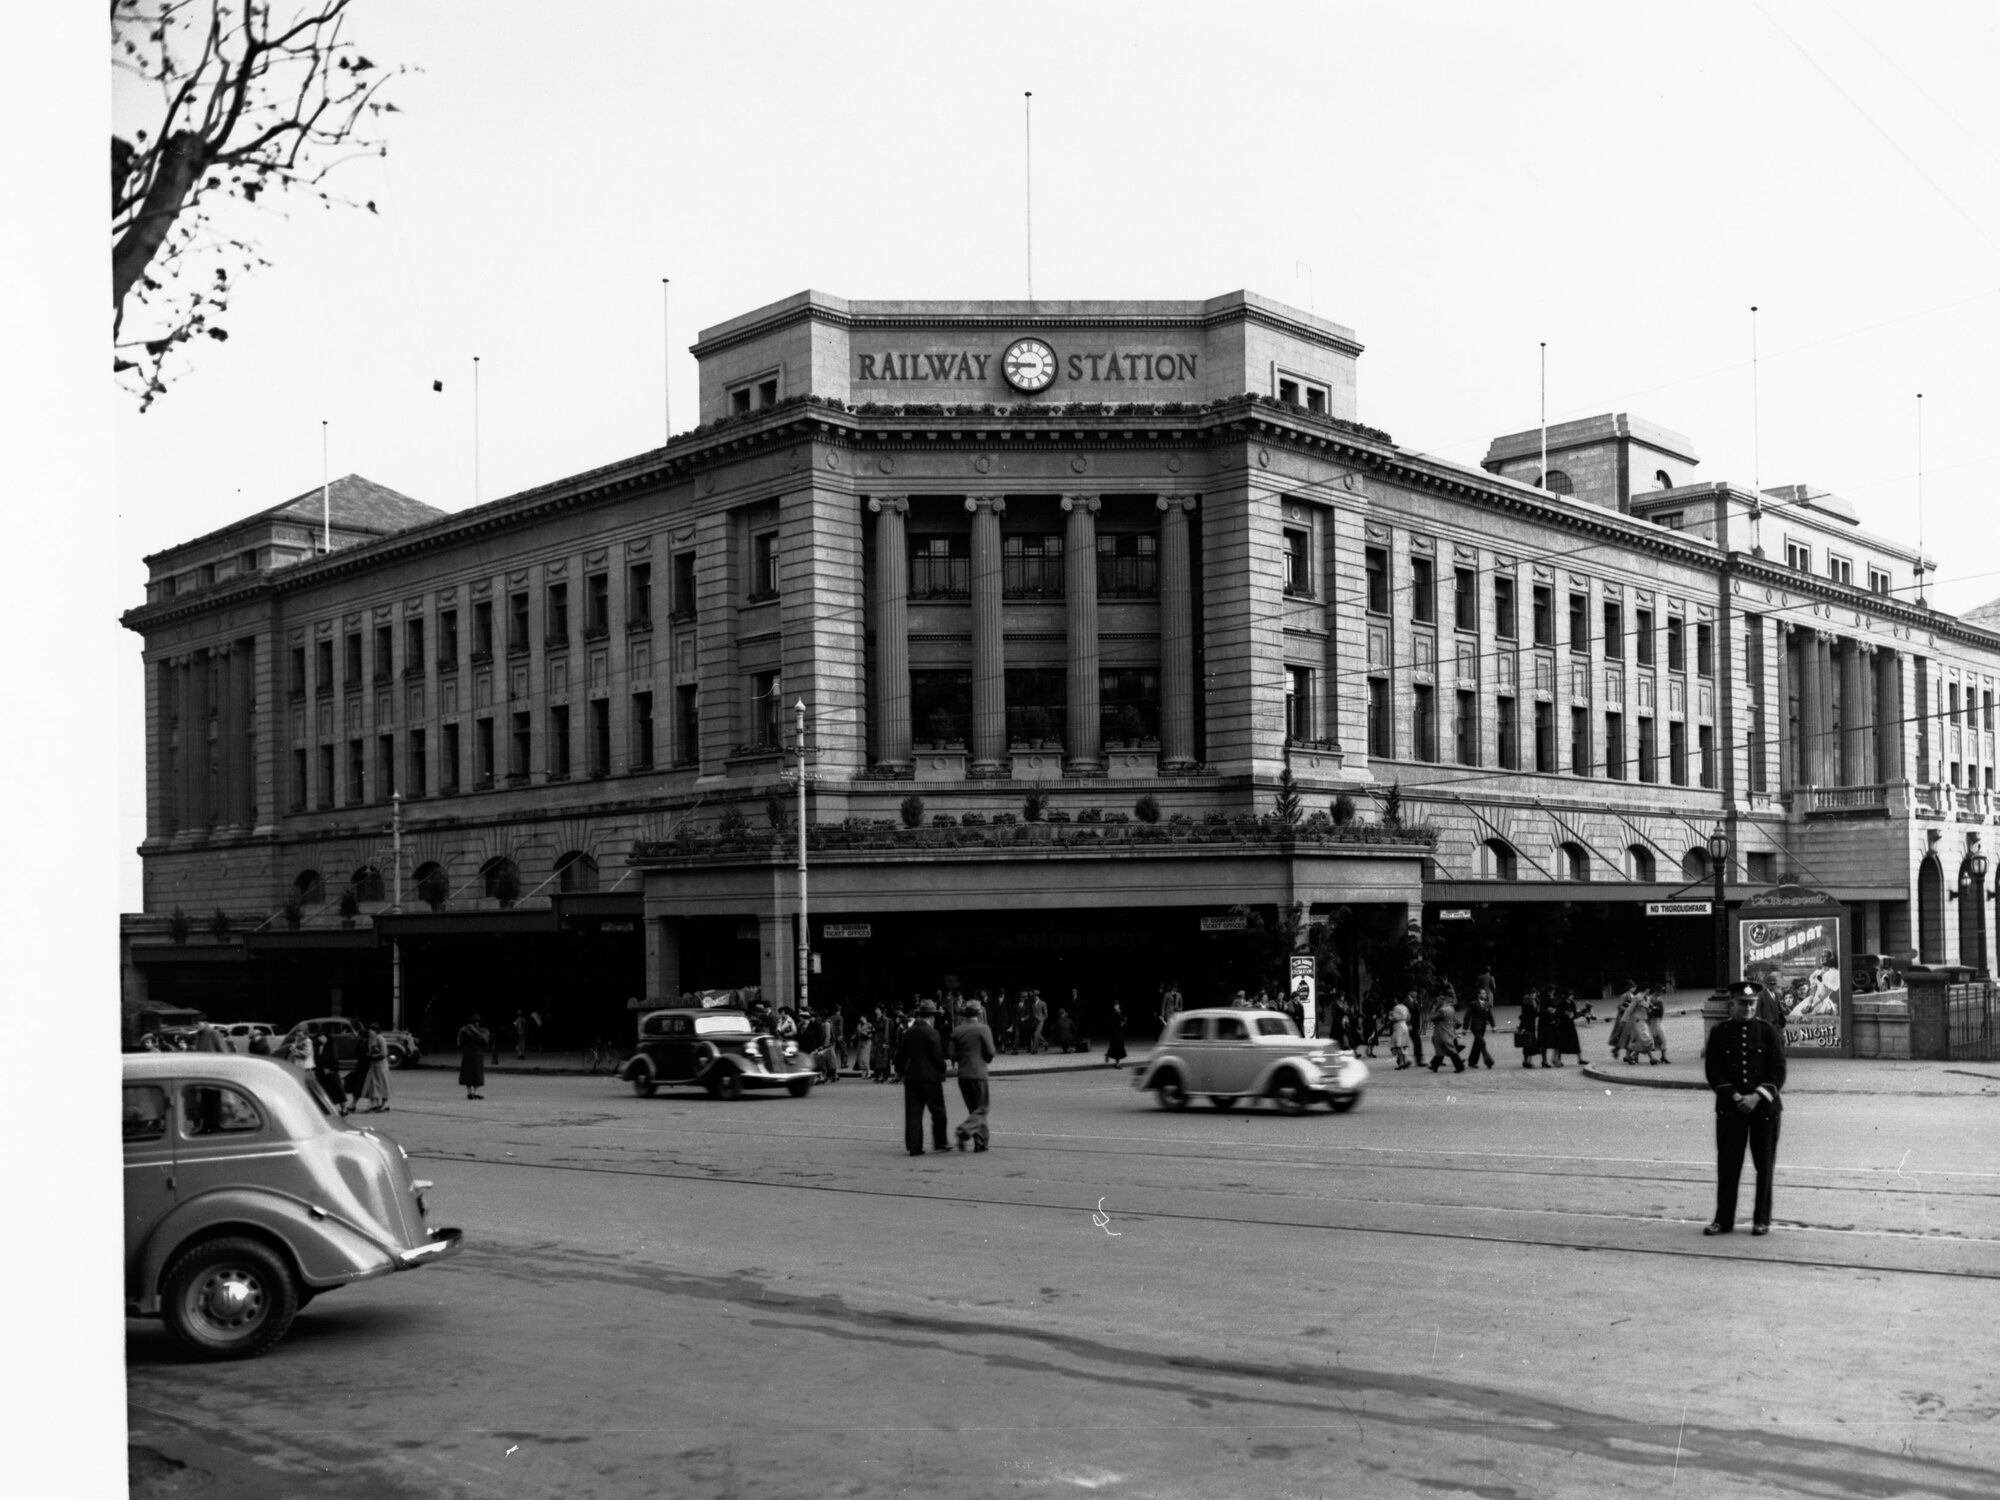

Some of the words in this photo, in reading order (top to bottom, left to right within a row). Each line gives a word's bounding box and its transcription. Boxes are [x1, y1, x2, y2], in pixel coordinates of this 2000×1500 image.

[858, 351, 992, 381] RAILWAY
[1067, 351, 1198, 381] STATION
[1650, 905, 1660, 913] NO
[1661, 904, 1708, 913] THOROUGHFARE
[1749, 939, 1785, 962] SHOW
[1787, 925, 1823, 950] BOAT
[1799, 1025, 1836, 1042] NIGHT
[1817, 1037, 1840, 1047] OUT
